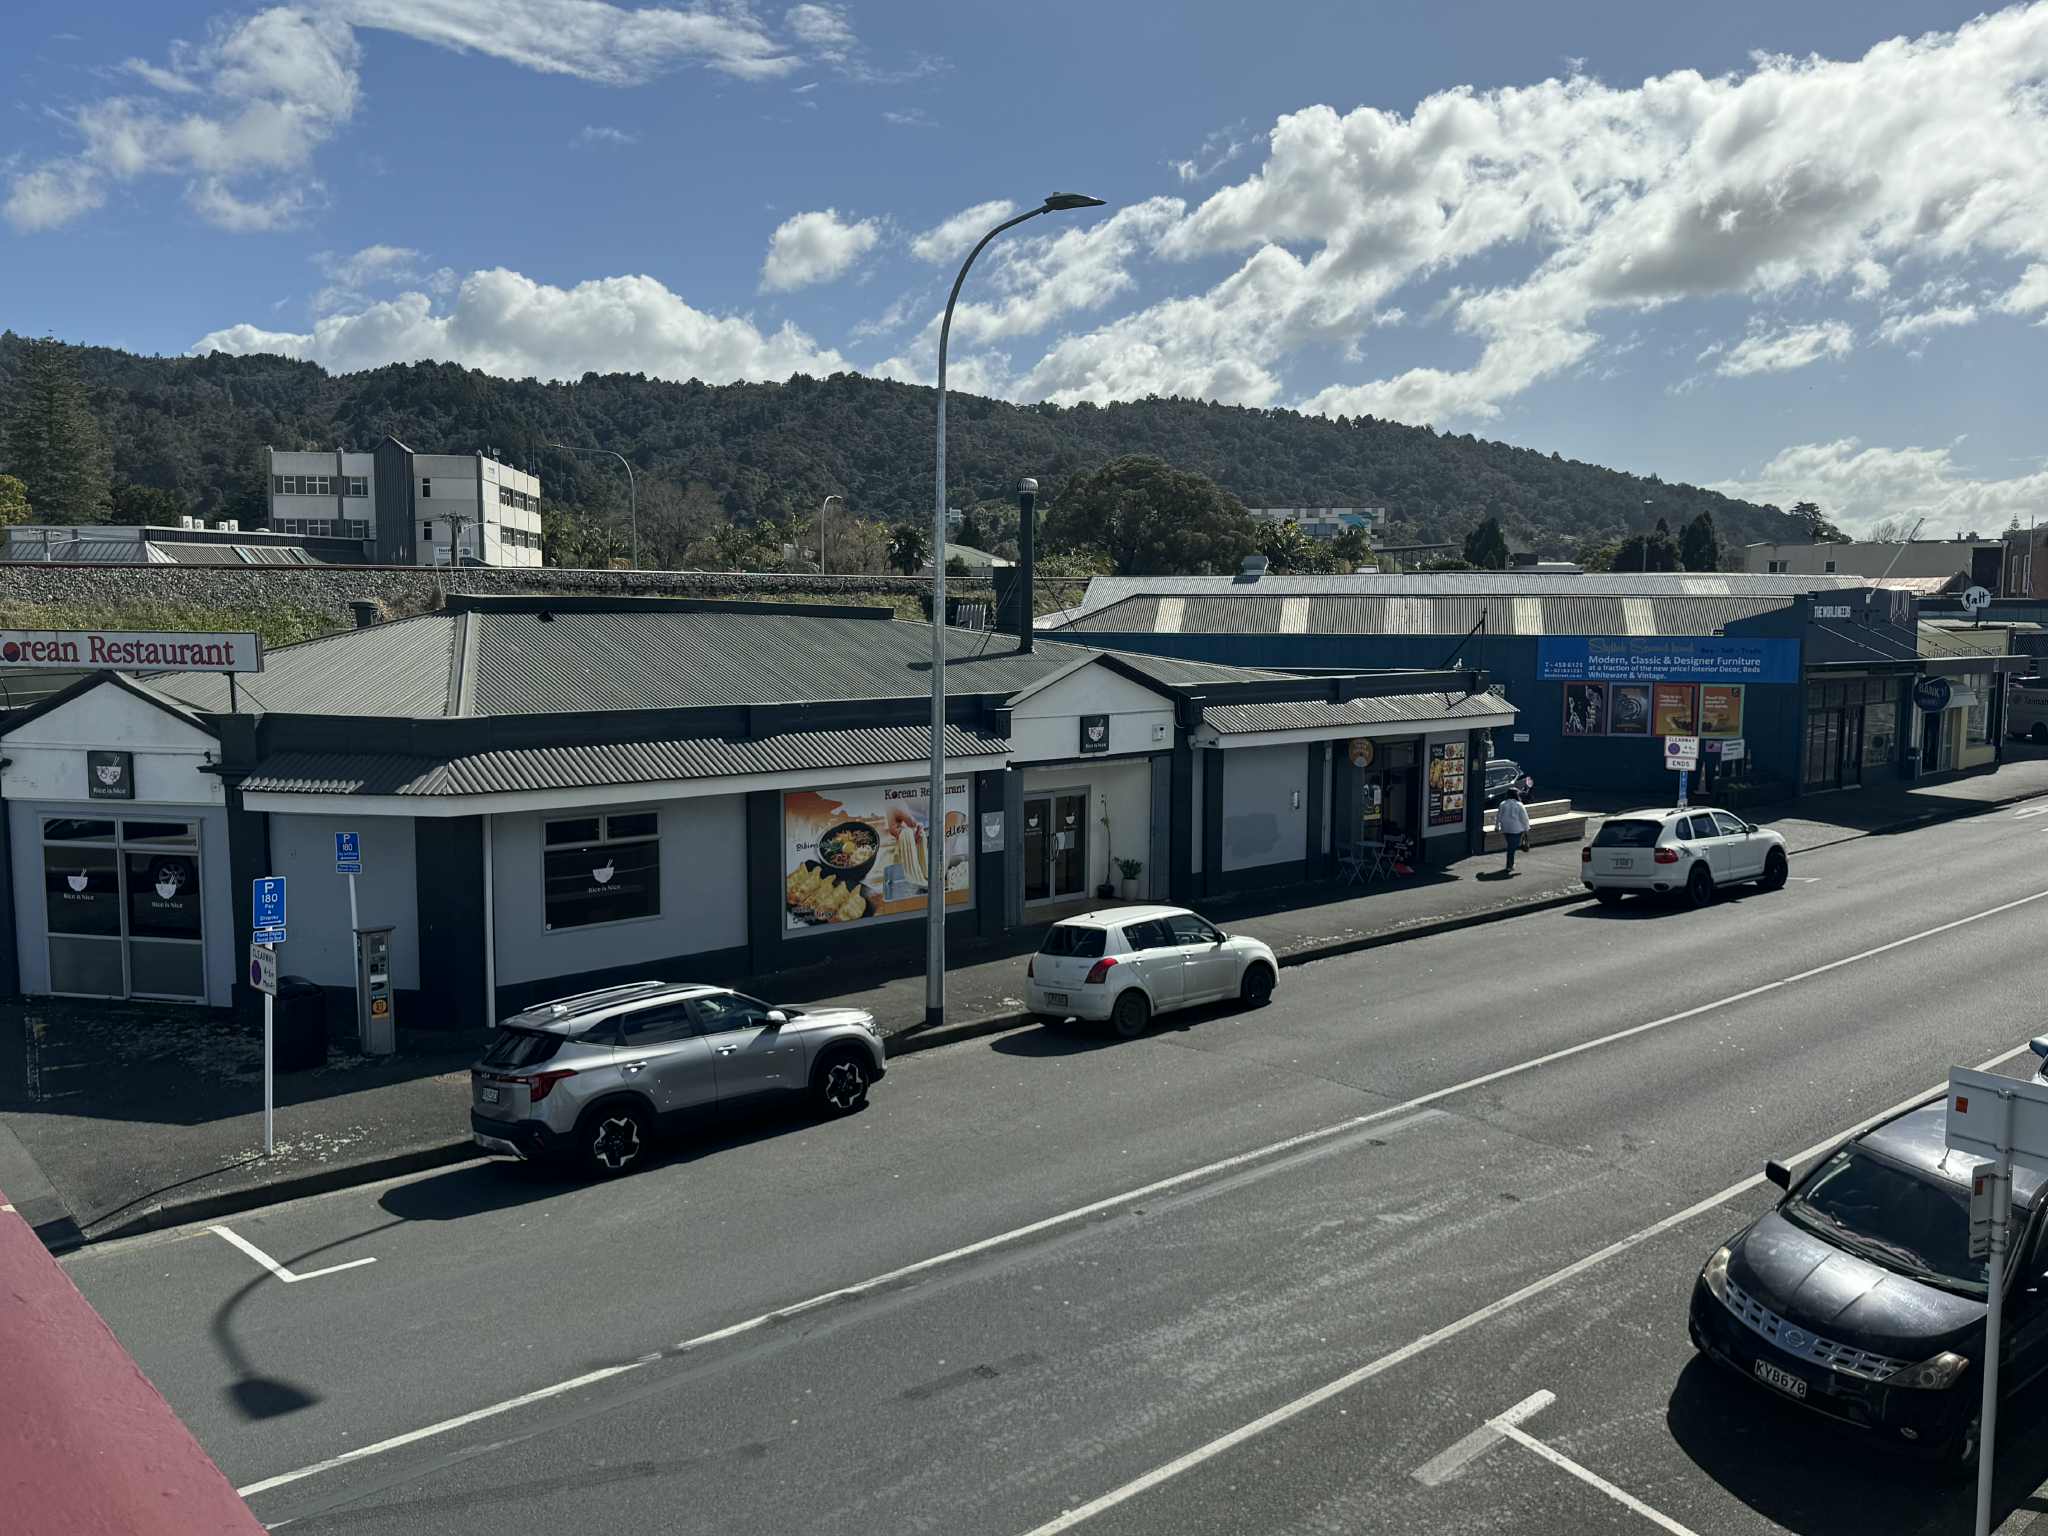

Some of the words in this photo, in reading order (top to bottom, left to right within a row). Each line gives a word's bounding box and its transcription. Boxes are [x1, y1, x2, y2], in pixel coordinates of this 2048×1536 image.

[88, 636, 235, 666] Restaurant
[1588, 656, 1628, 665] Modern,
[1631, 656, 1663, 665] Classic
[1663, 656, 1671, 665] &
[1674, 656, 1714, 666] Designer
[1717, 656, 1761, 666] Furniture
[1588, 671, 1628, 679] Whiteware
[884, 789, 917, 800] Korean
[343, 834, 351, 843] P
[264, 882, 274, 894] P
[261, 893, 278, 903] 180
